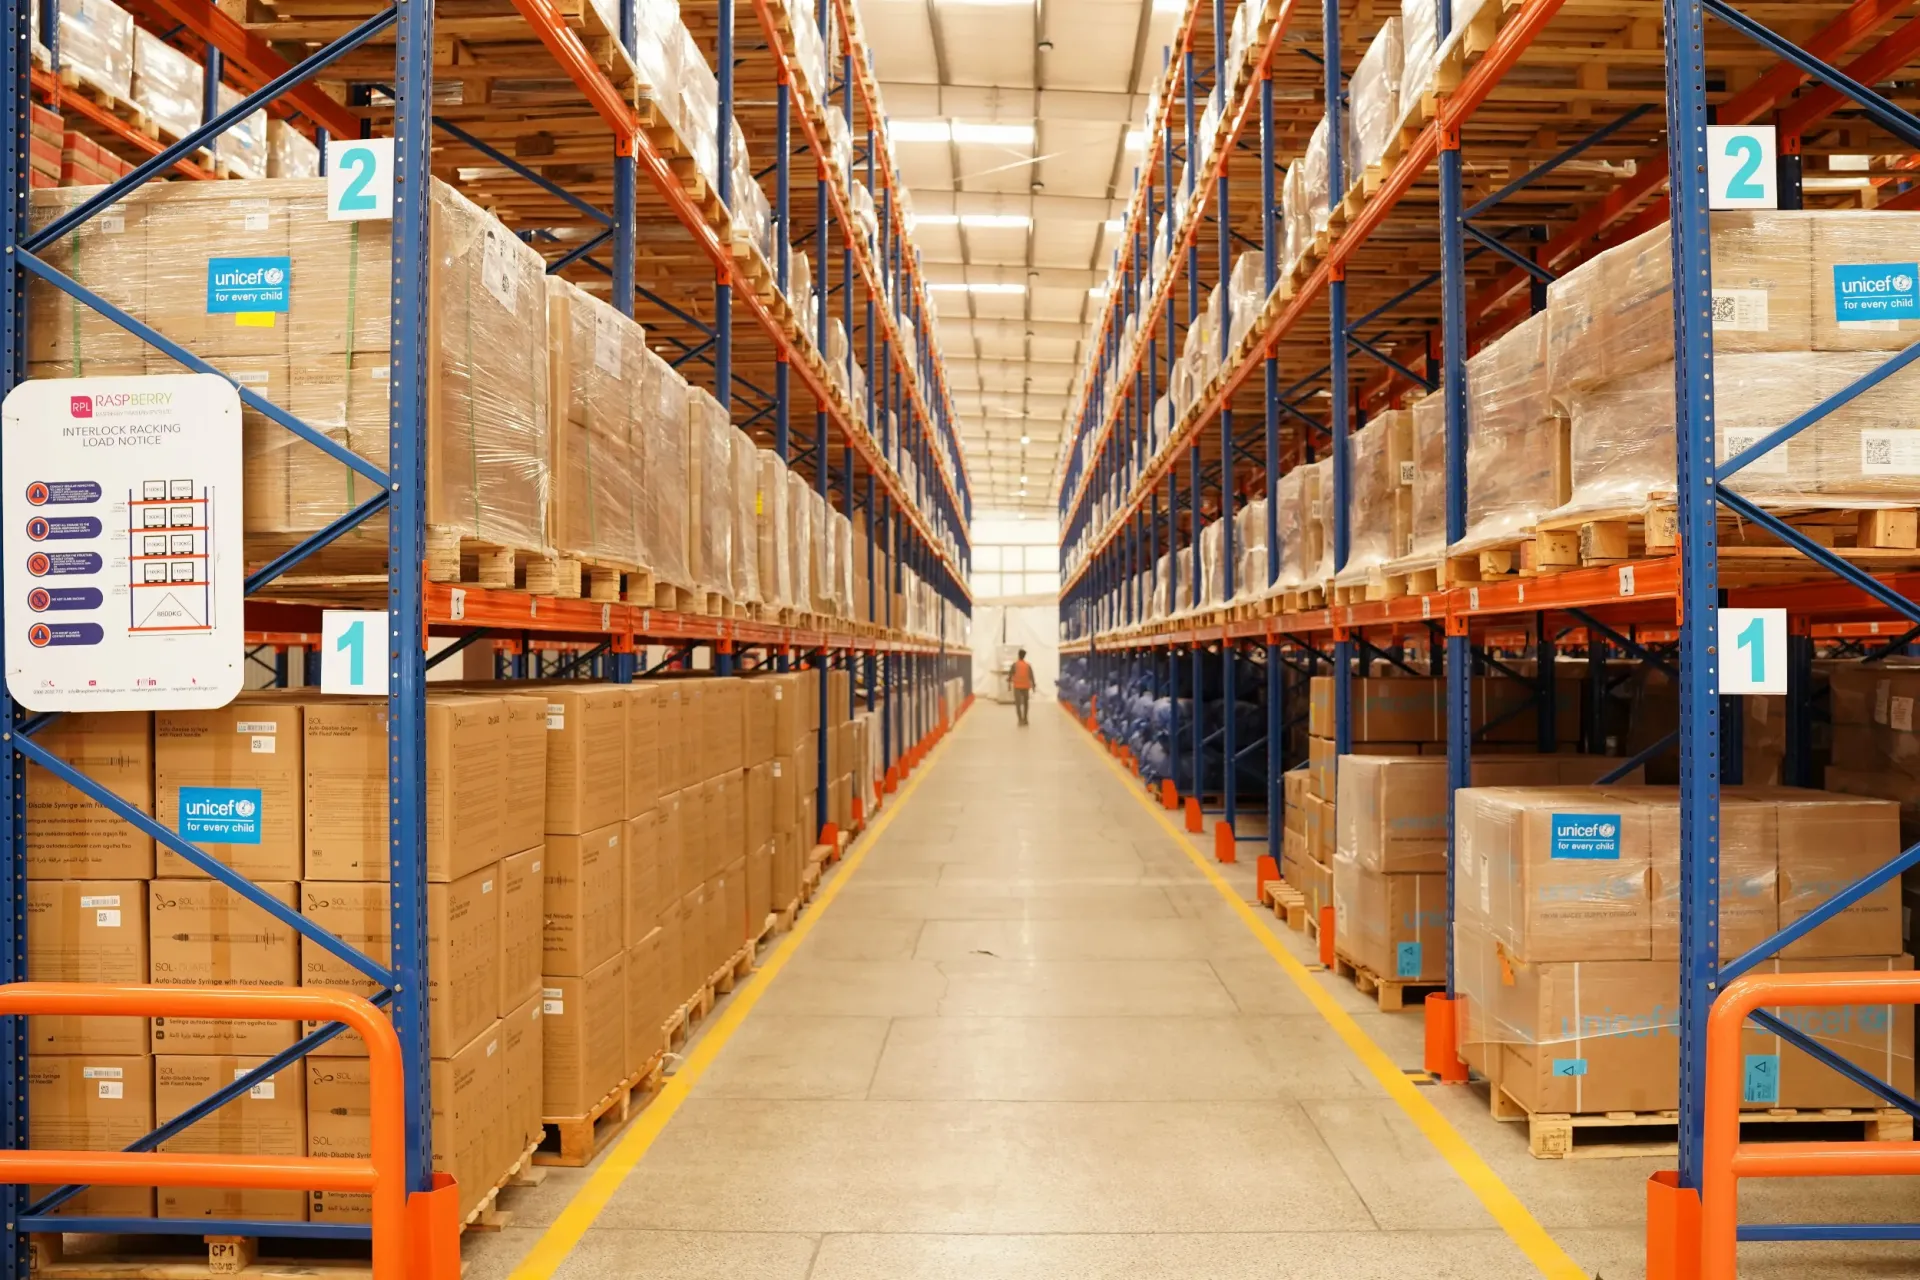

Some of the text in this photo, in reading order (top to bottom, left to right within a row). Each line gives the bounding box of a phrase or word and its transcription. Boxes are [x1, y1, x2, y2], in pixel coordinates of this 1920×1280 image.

[1725, 135, 1764, 198] 2
[338, 148, 377, 211] 2
[215, 268, 264, 286] unicef
[1842, 275, 1891, 293] unicef
[215, 291, 283, 302] for every child
[1844, 298, 1913, 310] for every child
[72, 402, 91, 412] RPL
[95, 393, 172, 407] RASPBERRY
[62, 423, 181, 436] INTERLOCK RACKING
[82, 435, 161, 447] LOAD NOTICE
[337, 620, 364, 686] 1
[1737, 618, 1765, 683] 1
[186, 799, 235, 816] unicef
[187, 822, 255, 833] for every child
[1557, 823, 1599, 837] unicef
[1558, 842, 1614, 851] for every child
[155, 977, 197, 985] Auto-Disable
[198, 978, 222, 986] Syringe
[224, 978, 237, 986] with
[351, 978, 376, 986] Syringe
[1561, 1005, 1664, 1039] unicef
